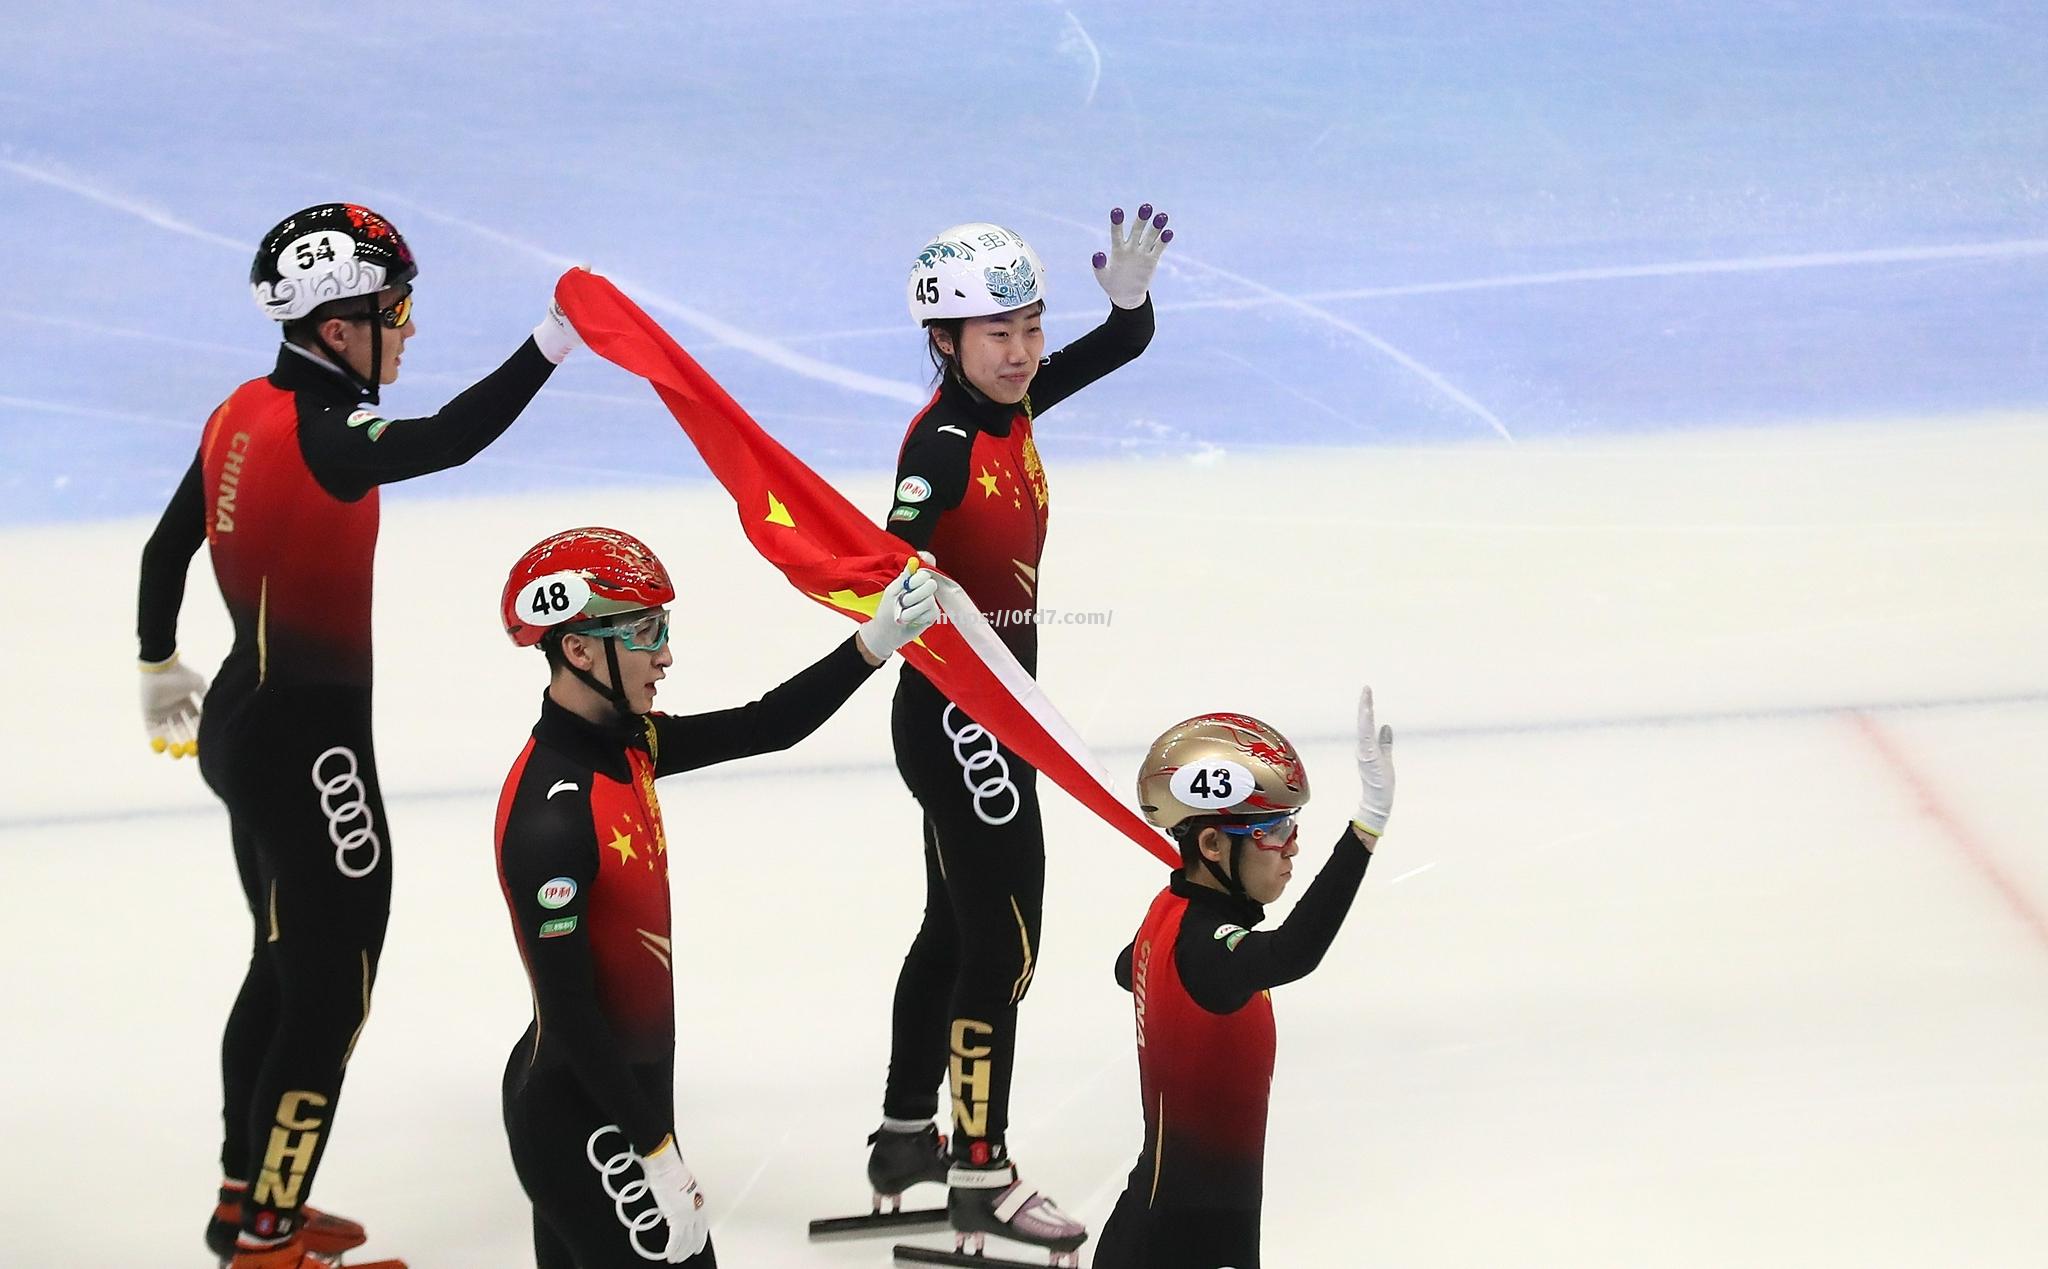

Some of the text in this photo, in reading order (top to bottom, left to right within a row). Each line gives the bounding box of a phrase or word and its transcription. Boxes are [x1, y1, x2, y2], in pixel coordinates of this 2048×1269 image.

[295, 237, 336, 270] 54
[916, 277, 940, 305] 45
[216, 431, 250, 533] CHINA
[531, 582, 570, 616] 48
[1189, 768, 1233, 799] 43
[544, 886, 572, 900] 伊利
[1136, 940, 1151, 1048] CHINA
[950, 1018, 994, 1138] CHN
[253, 1090, 328, 1209] CHN
